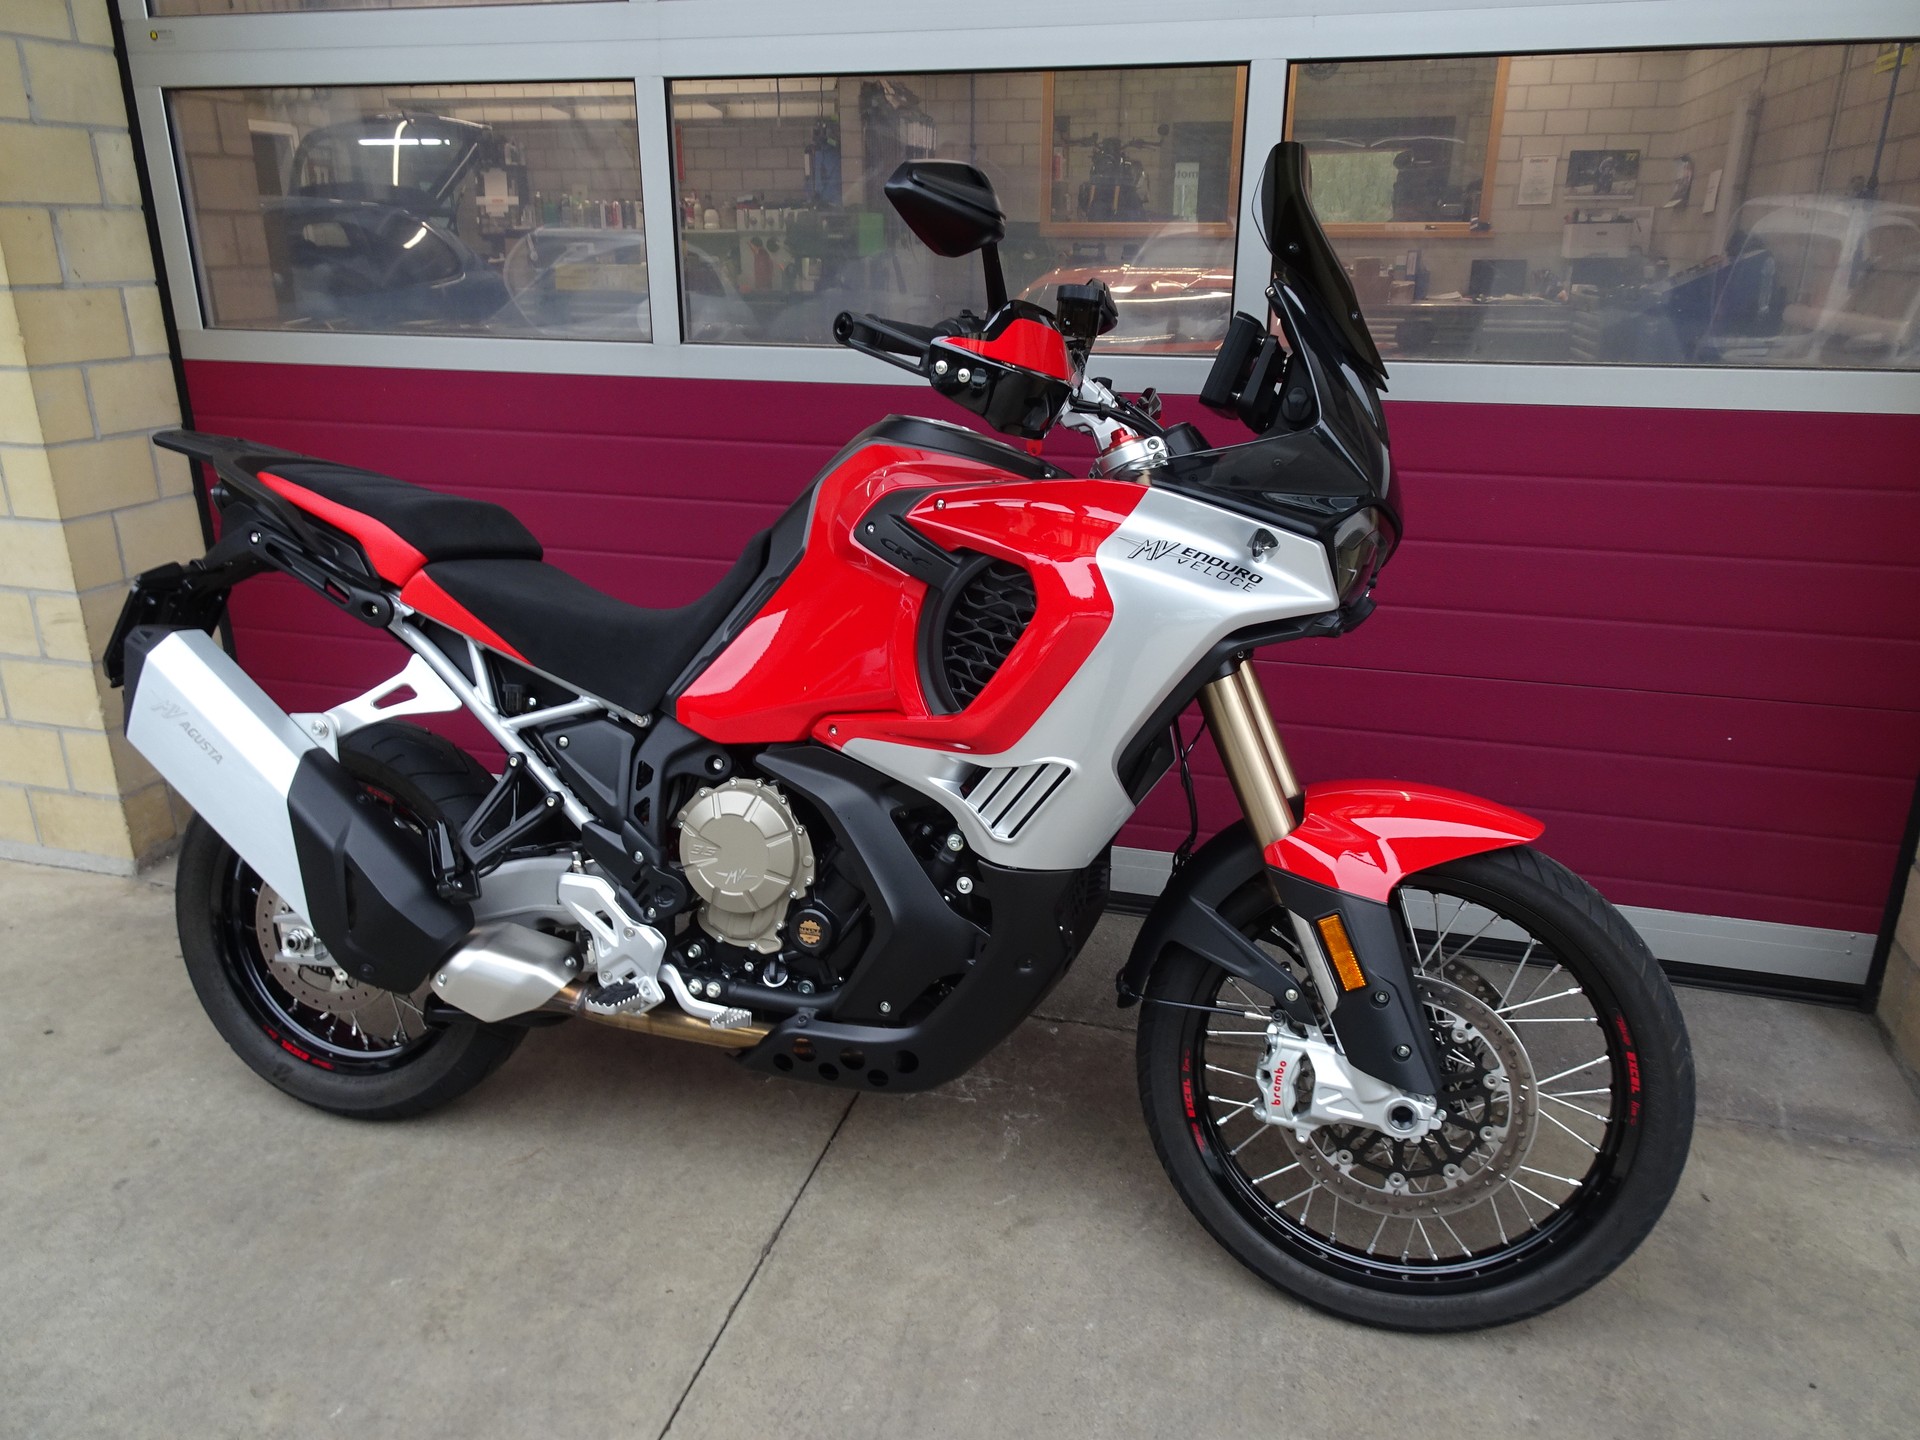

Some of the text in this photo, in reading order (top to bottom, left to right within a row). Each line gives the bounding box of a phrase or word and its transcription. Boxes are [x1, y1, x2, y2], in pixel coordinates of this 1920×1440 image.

[880, 538, 932, 568] CRC
[1128, 539, 1264, 584] MV ENDURO
[1178, 558, 1257, 593] VELOCE
[179, 721, 223, 765] AGUSTA
[1271, 1061, 1287, 1106] brembo
